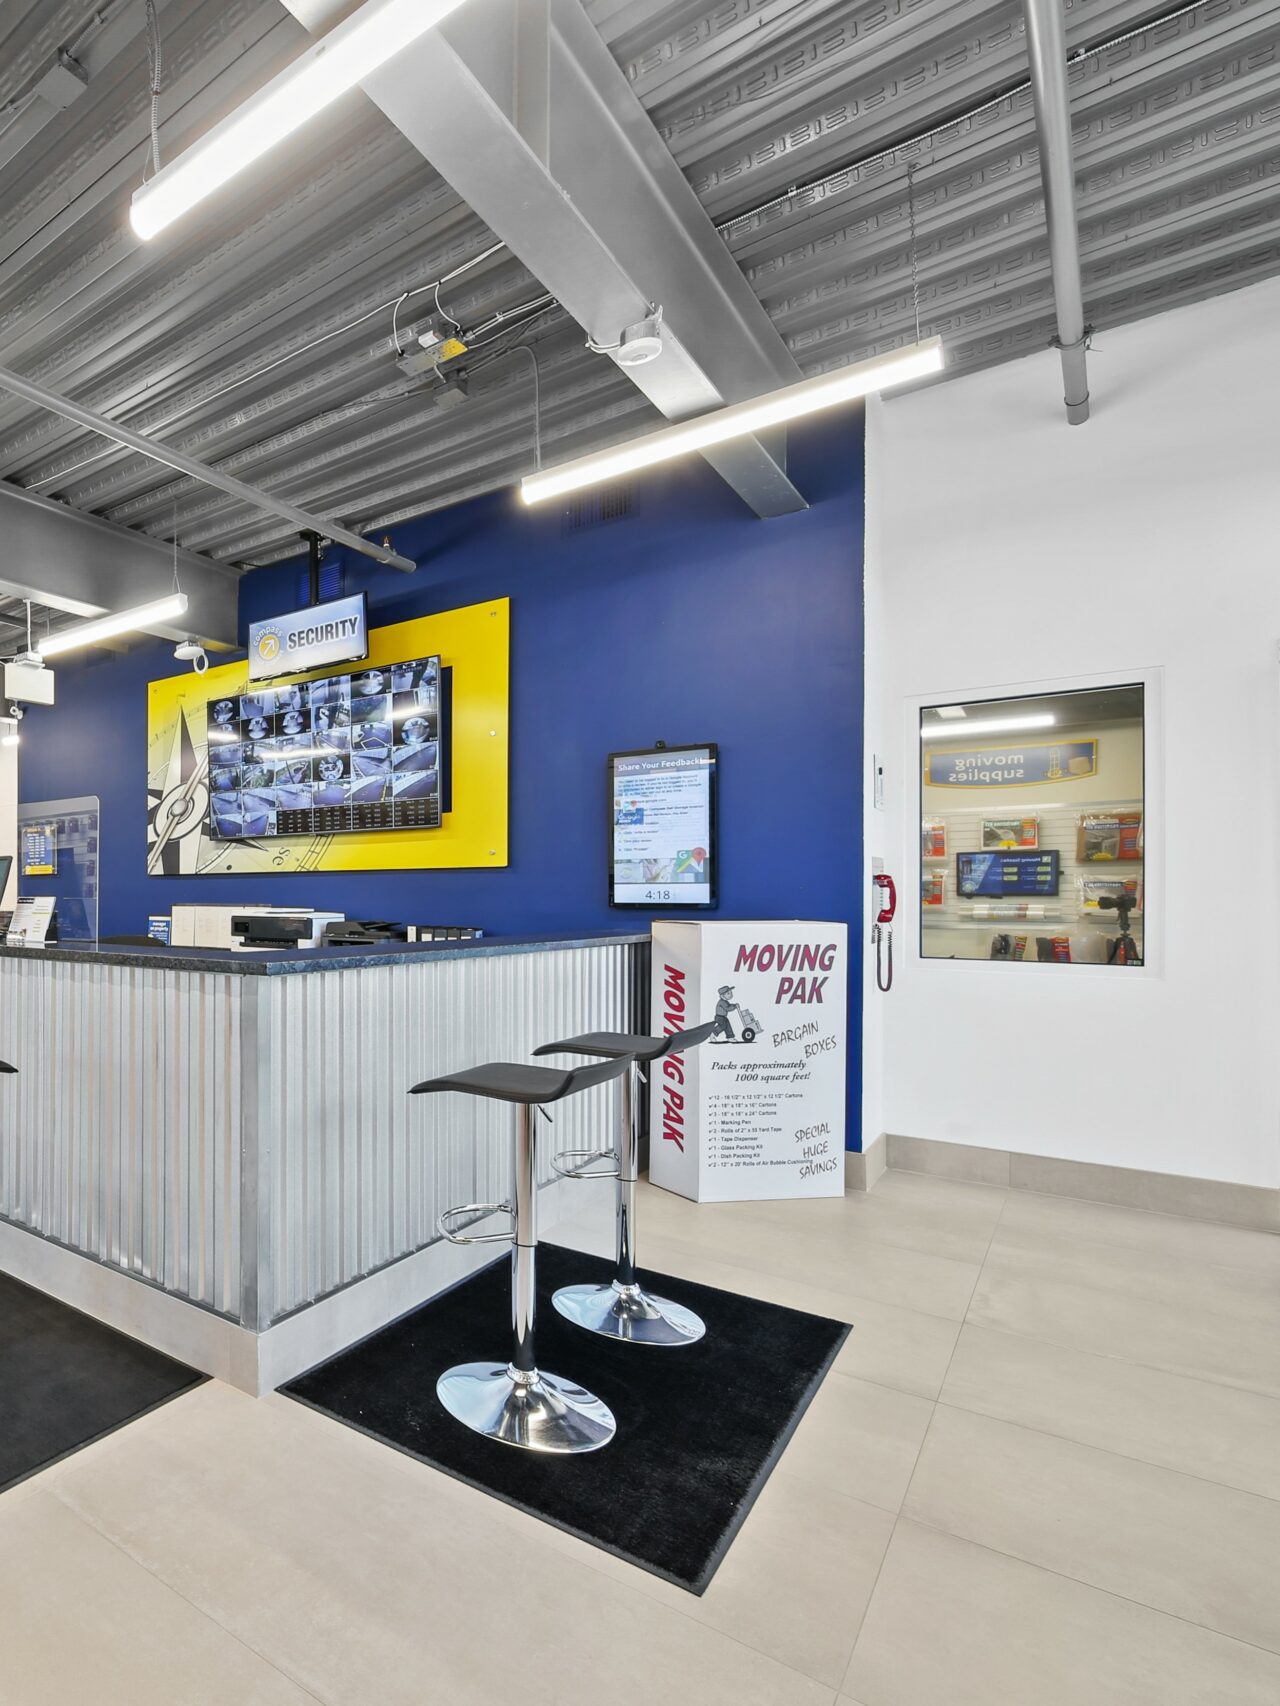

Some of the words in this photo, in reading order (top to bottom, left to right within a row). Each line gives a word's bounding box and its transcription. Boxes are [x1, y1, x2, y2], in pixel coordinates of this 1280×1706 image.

[253, 625, 283, 647] compass
[288, 617, 358, 650] SECURITY
[618, 764, 640, 772] Share
[645, 890, 670, 900] 4:18
[734, 944, 837, 972] MOVING
[775, 977, 829, 1004] PAK
[663, 964, 685, 1086] MOVG
[772, 1020, 819, 1048] BARGAIN
[804, 1035, 837, 1059] BOXES
[711, 1061, 738, 1070] Packs
[740, 1060, 807, 1072] approximately
[735, 1073, 758, 1082] 1000
[760, 1074, 790, 1083] square
[791, 1072, 811, 1082] feet!
[662, 1084, 684, 1153] PAK
[794, 1122, 831, 1143] SPECIAL
[802, 1141, 829, 1159] HUGE
[799, 1157, 838, 1180] SAVINGS
